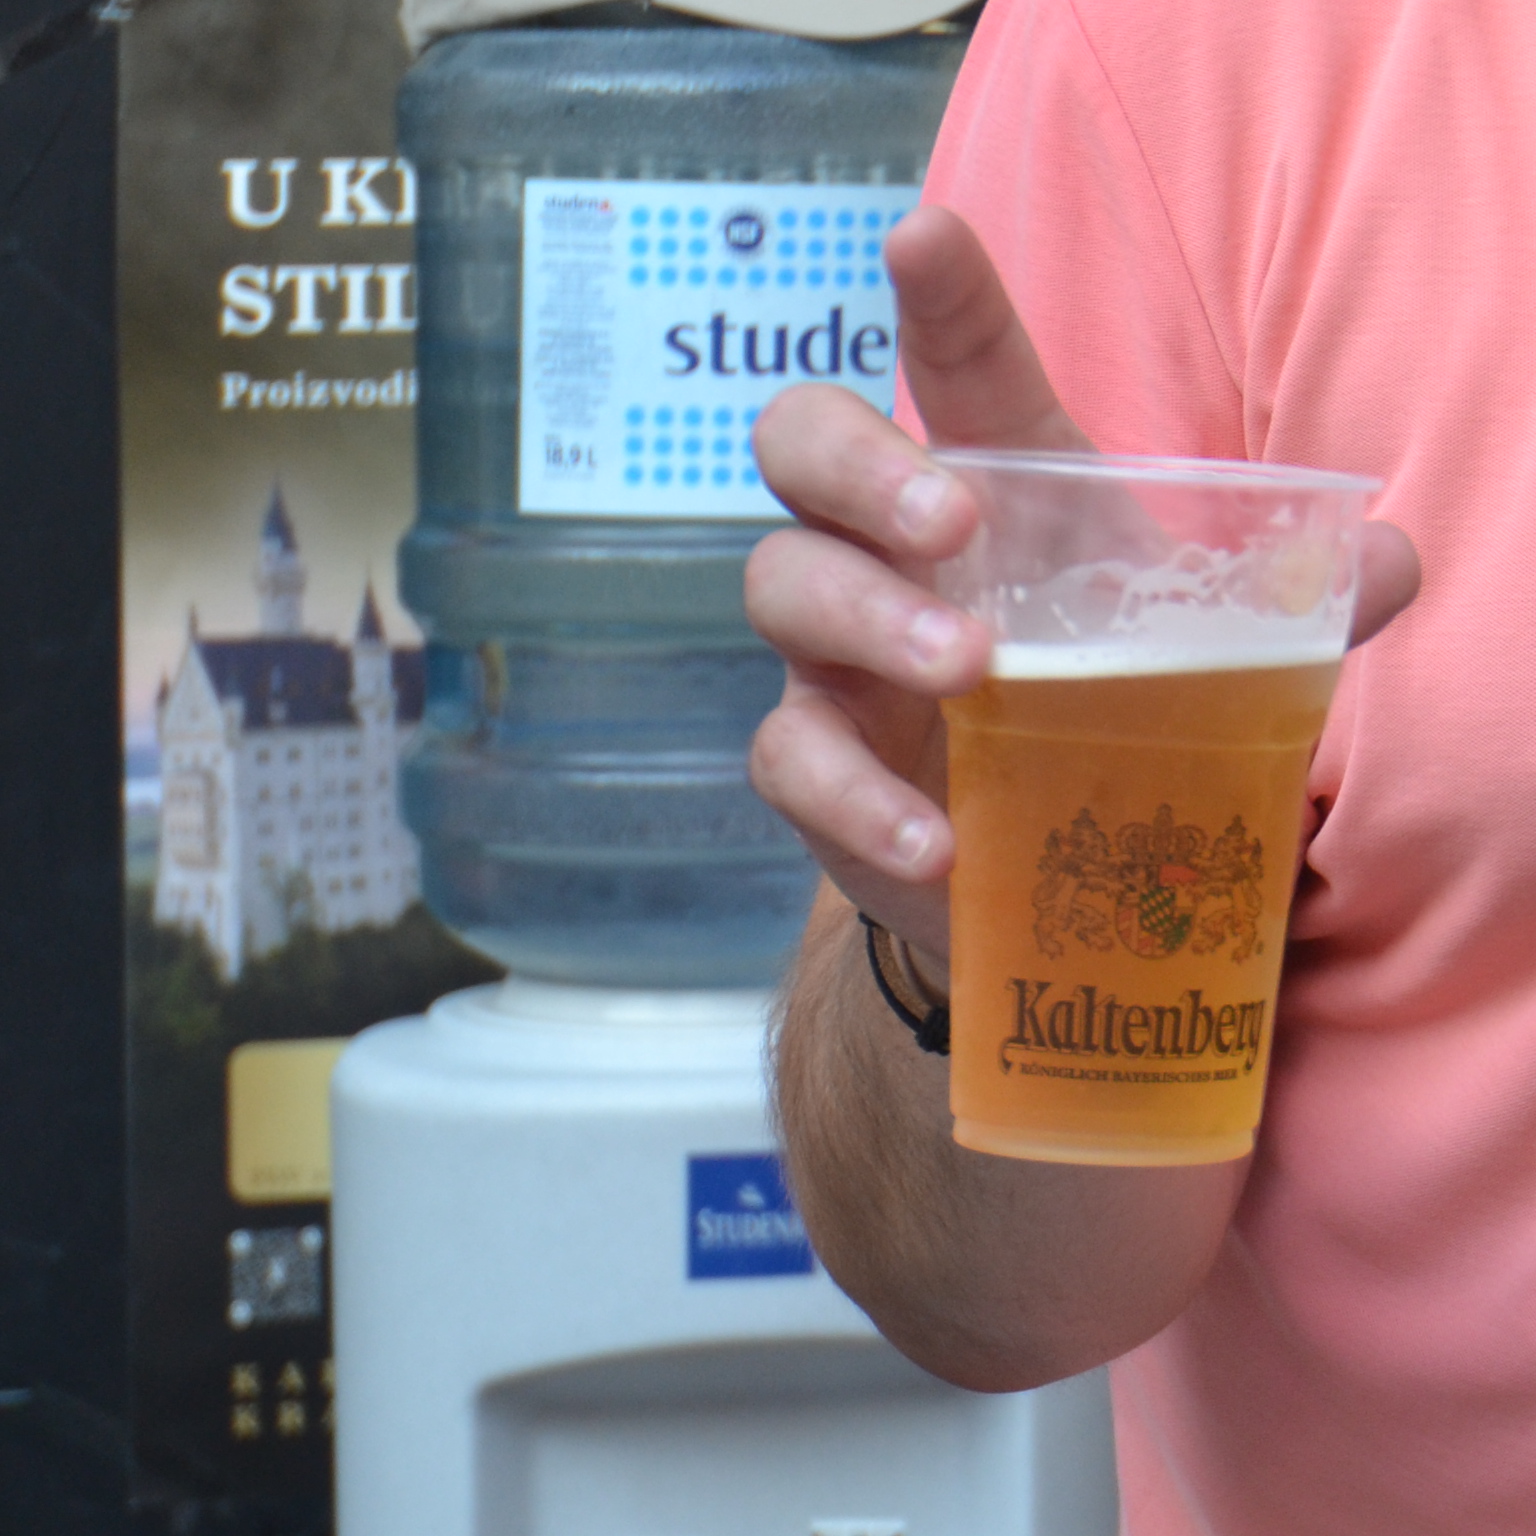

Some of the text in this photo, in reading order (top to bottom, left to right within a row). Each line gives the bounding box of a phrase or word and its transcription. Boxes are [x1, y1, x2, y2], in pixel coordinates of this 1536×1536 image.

[220, 157, 298, 230] U
[664, 304, 899, 378] stude
[1001, 976, 1266, 1076] Kaltenberg
